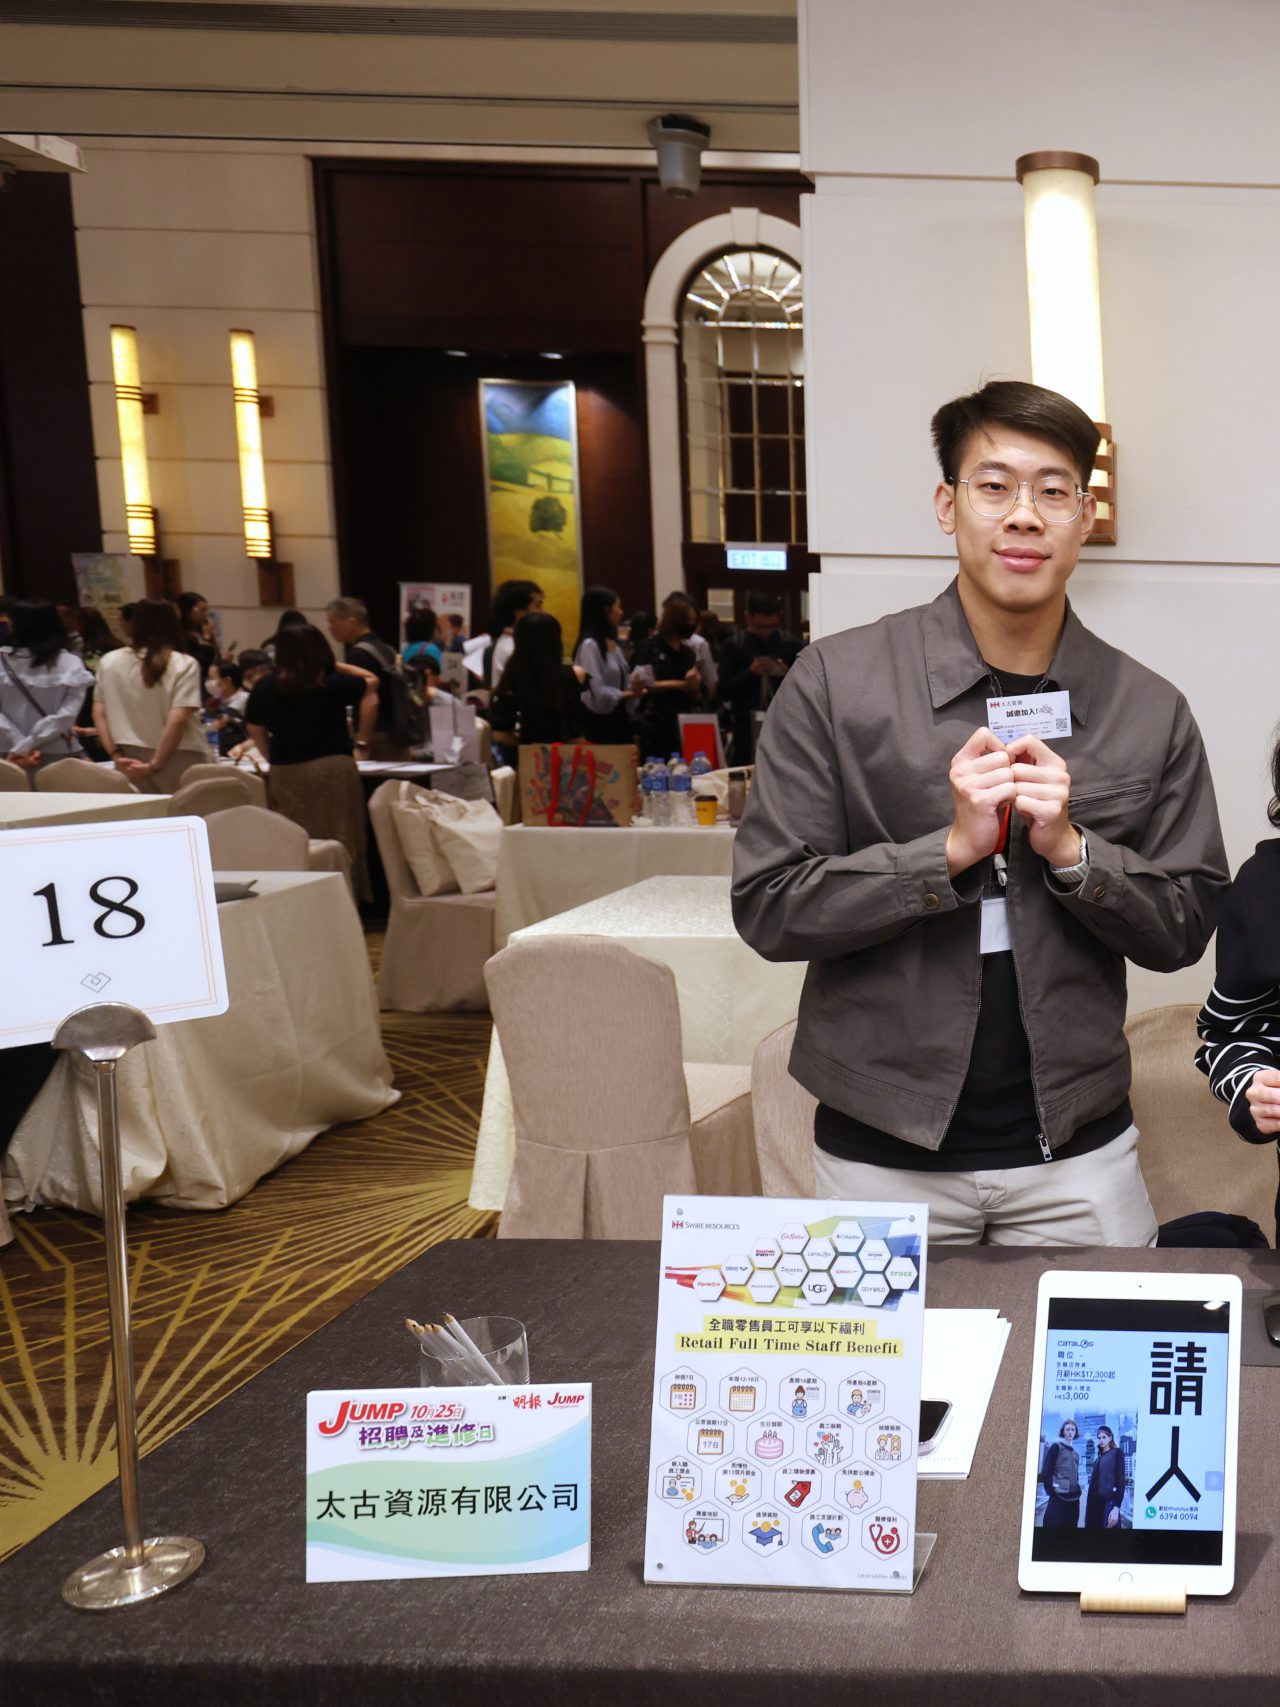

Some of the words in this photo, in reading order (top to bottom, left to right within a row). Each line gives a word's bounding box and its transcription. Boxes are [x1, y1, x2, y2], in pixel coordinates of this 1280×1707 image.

[731, 553, 757, 566] EXIT
[32, 874, 147, 949] 18
[808, 1283, 827, 1293] UGG
[709, 1318, 865, 1335] 全職零售員工可享以下福利
[680, 1336, 723, 1349] Retail
[729, 1338, 757, 1350] Full
[763, 1338, 800, 1351] Time
[805, 1339, 842, 1353] Staff
[847, 1341, 899, 1354] Benefit
[547, 1392, 585, 1405] JUMP
[318, 1399, 405, 1435] JUMP
[409, 1403, 464, 1420] 10月25日
[1145, 1341, 1208, 1503] 請人
[358, 1422, 495, 1449] 招聘及進修日
[316, 1483, 579, 1520] 太古資源有限公司
[1160, 1512, 1178, 1520] 6394
[1180, 1512, 1198, 1521] 0094
